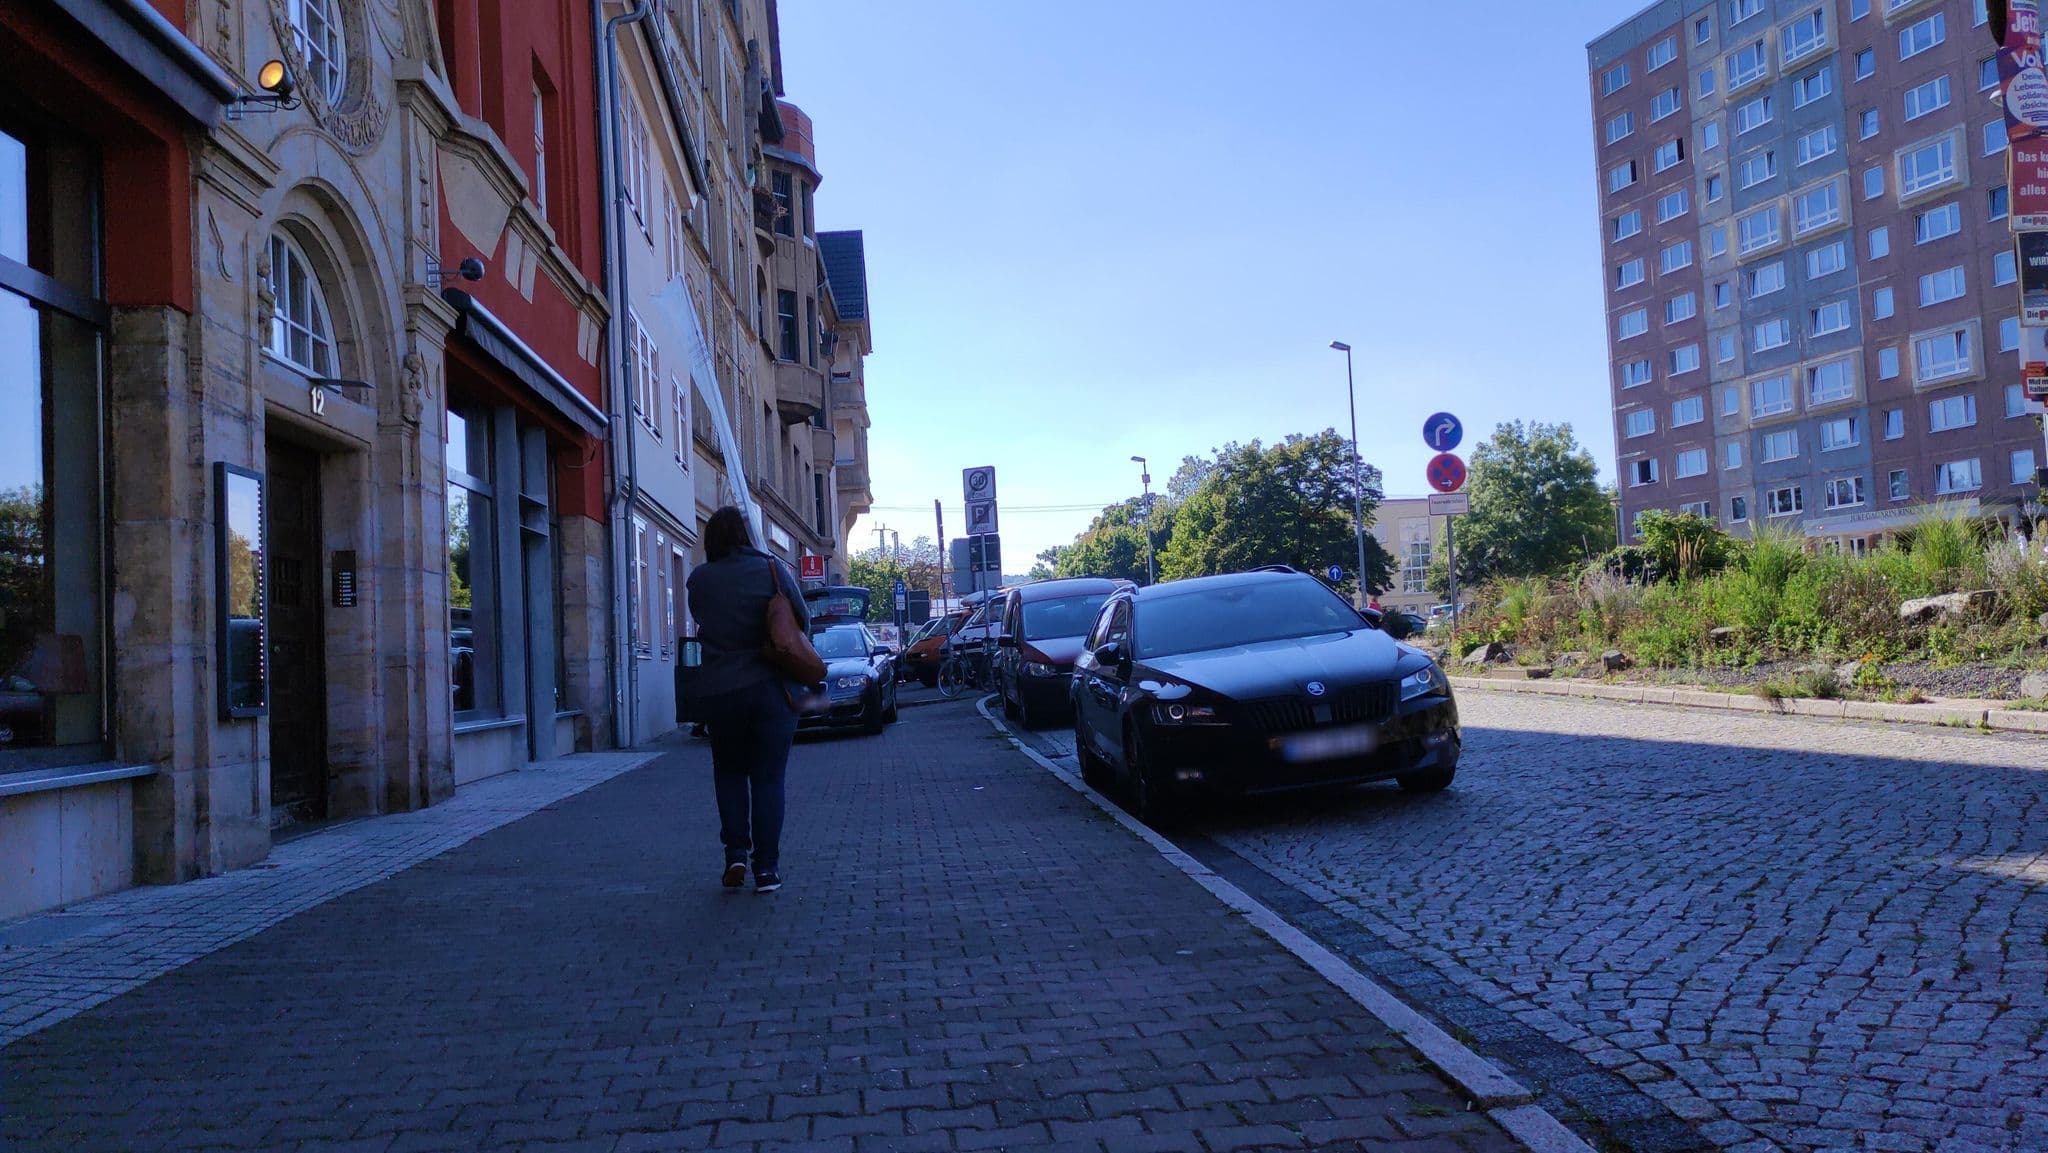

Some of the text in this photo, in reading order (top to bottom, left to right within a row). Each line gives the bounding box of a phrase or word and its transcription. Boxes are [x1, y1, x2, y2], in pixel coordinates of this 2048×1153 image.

[2017, 151, 2038, 163] Das
[2020, 184, 2047, 196] alles
[2027, 310, 2039, 319] Die
[311, 386, 325, 417] 12
[972, 474, 985, 487] 30
[975, 507, 985, 522] P
[896, 583, 904, 594] P
